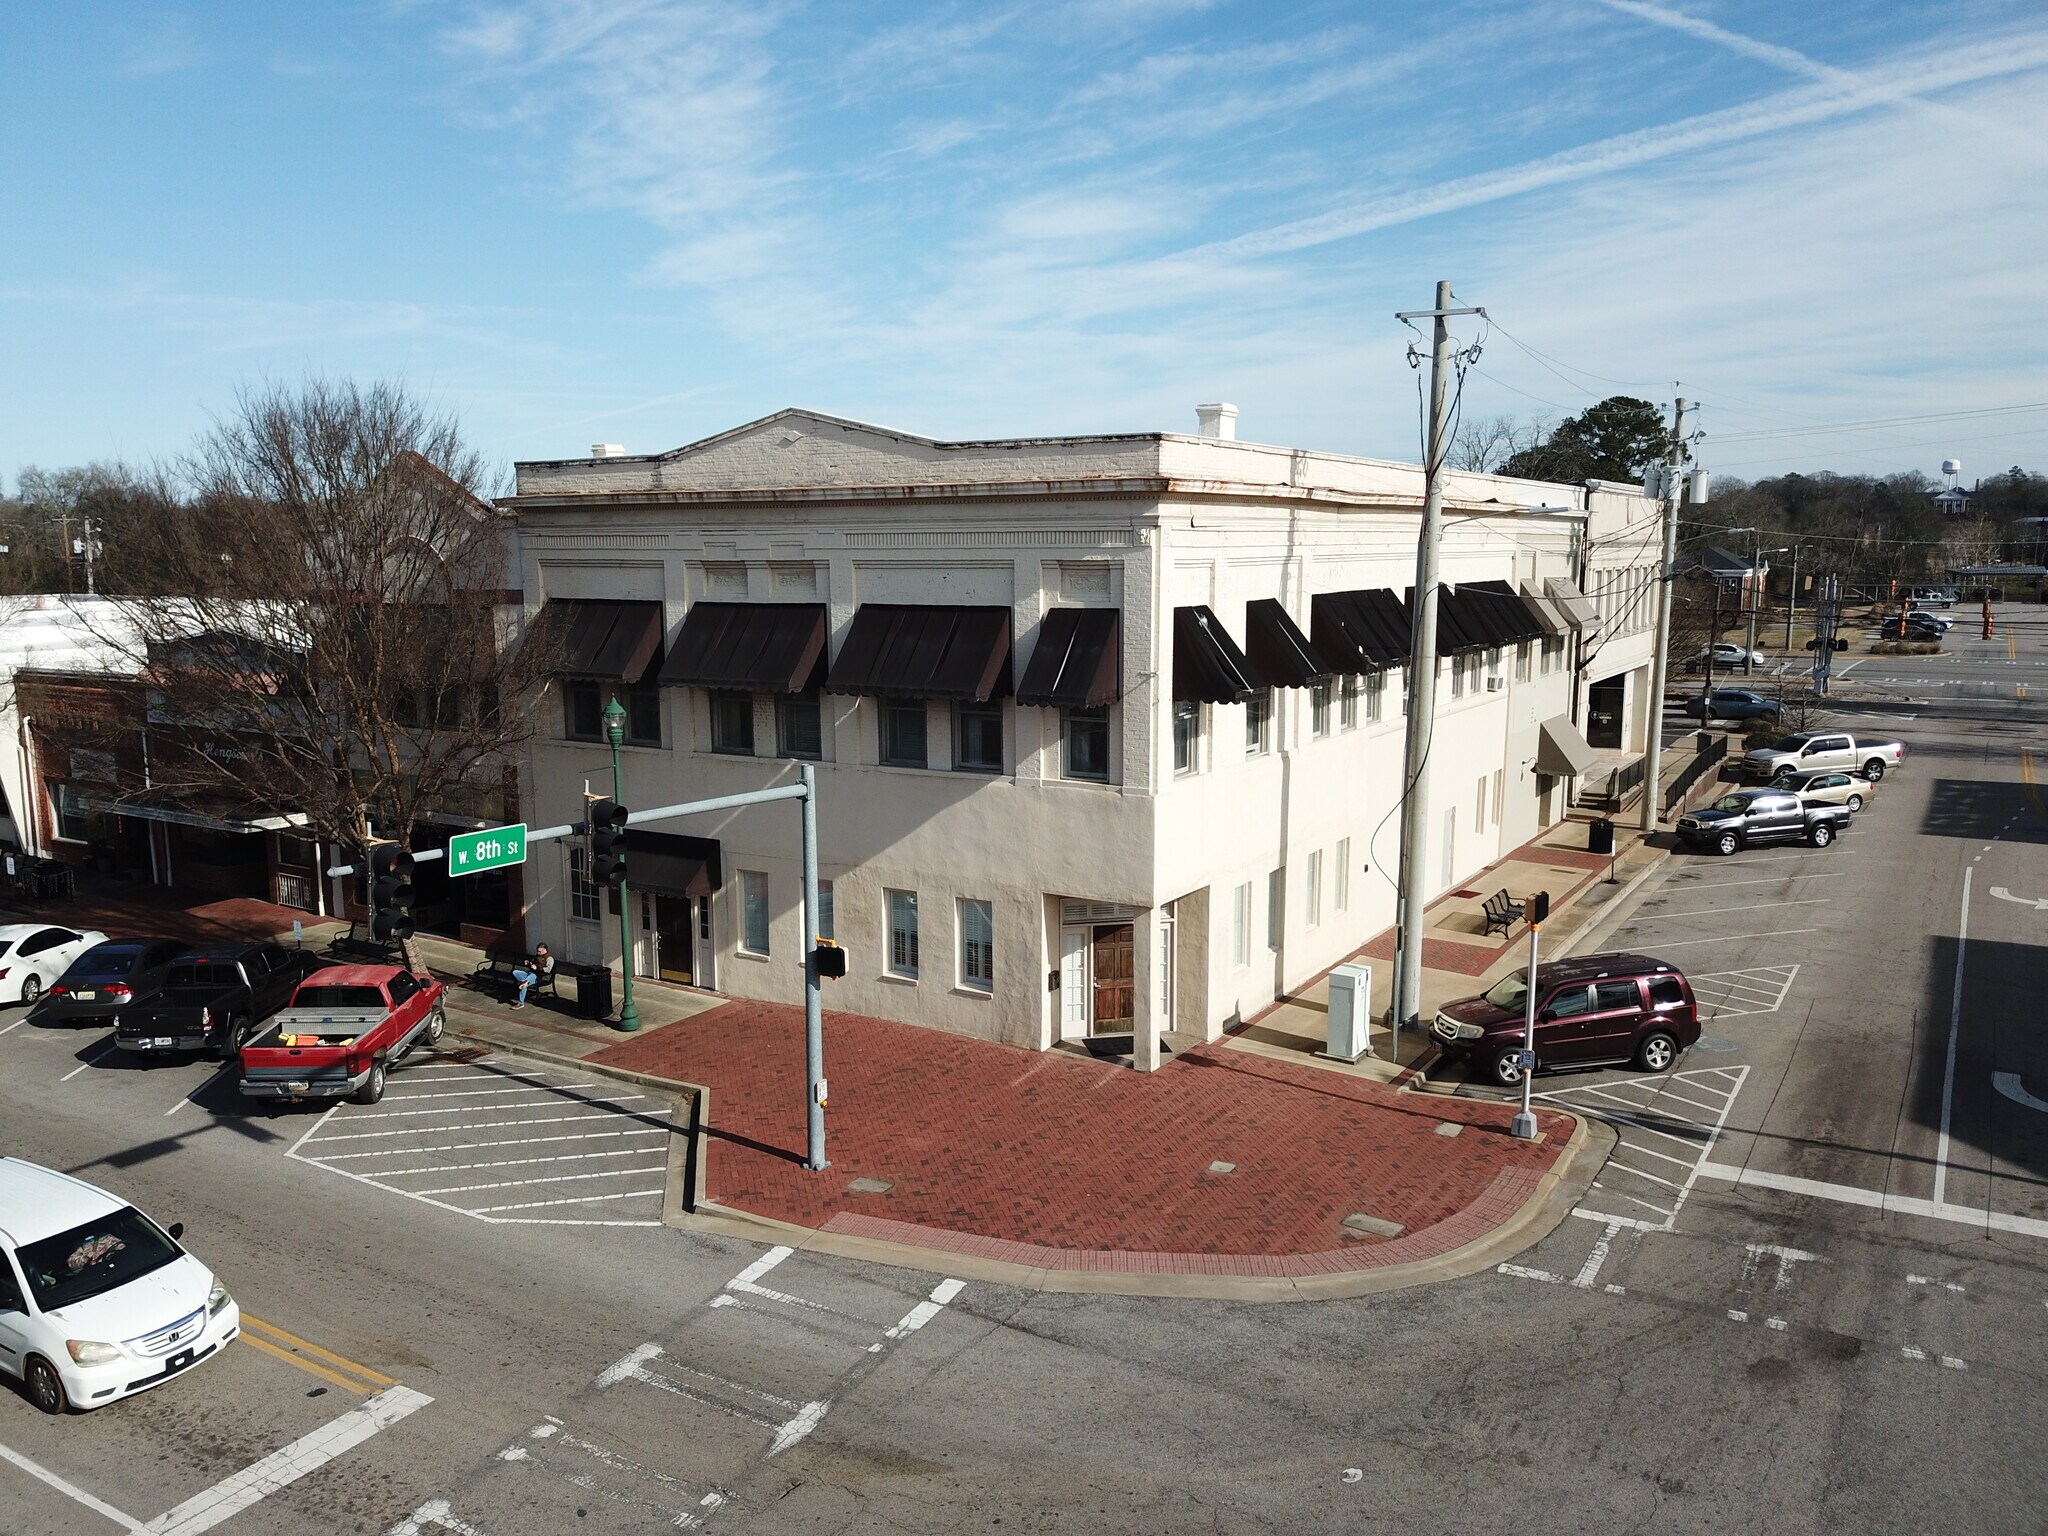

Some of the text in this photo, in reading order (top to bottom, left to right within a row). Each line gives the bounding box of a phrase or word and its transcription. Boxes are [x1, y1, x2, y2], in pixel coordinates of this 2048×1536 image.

[458, 839, 518, 865] W. 8th St
